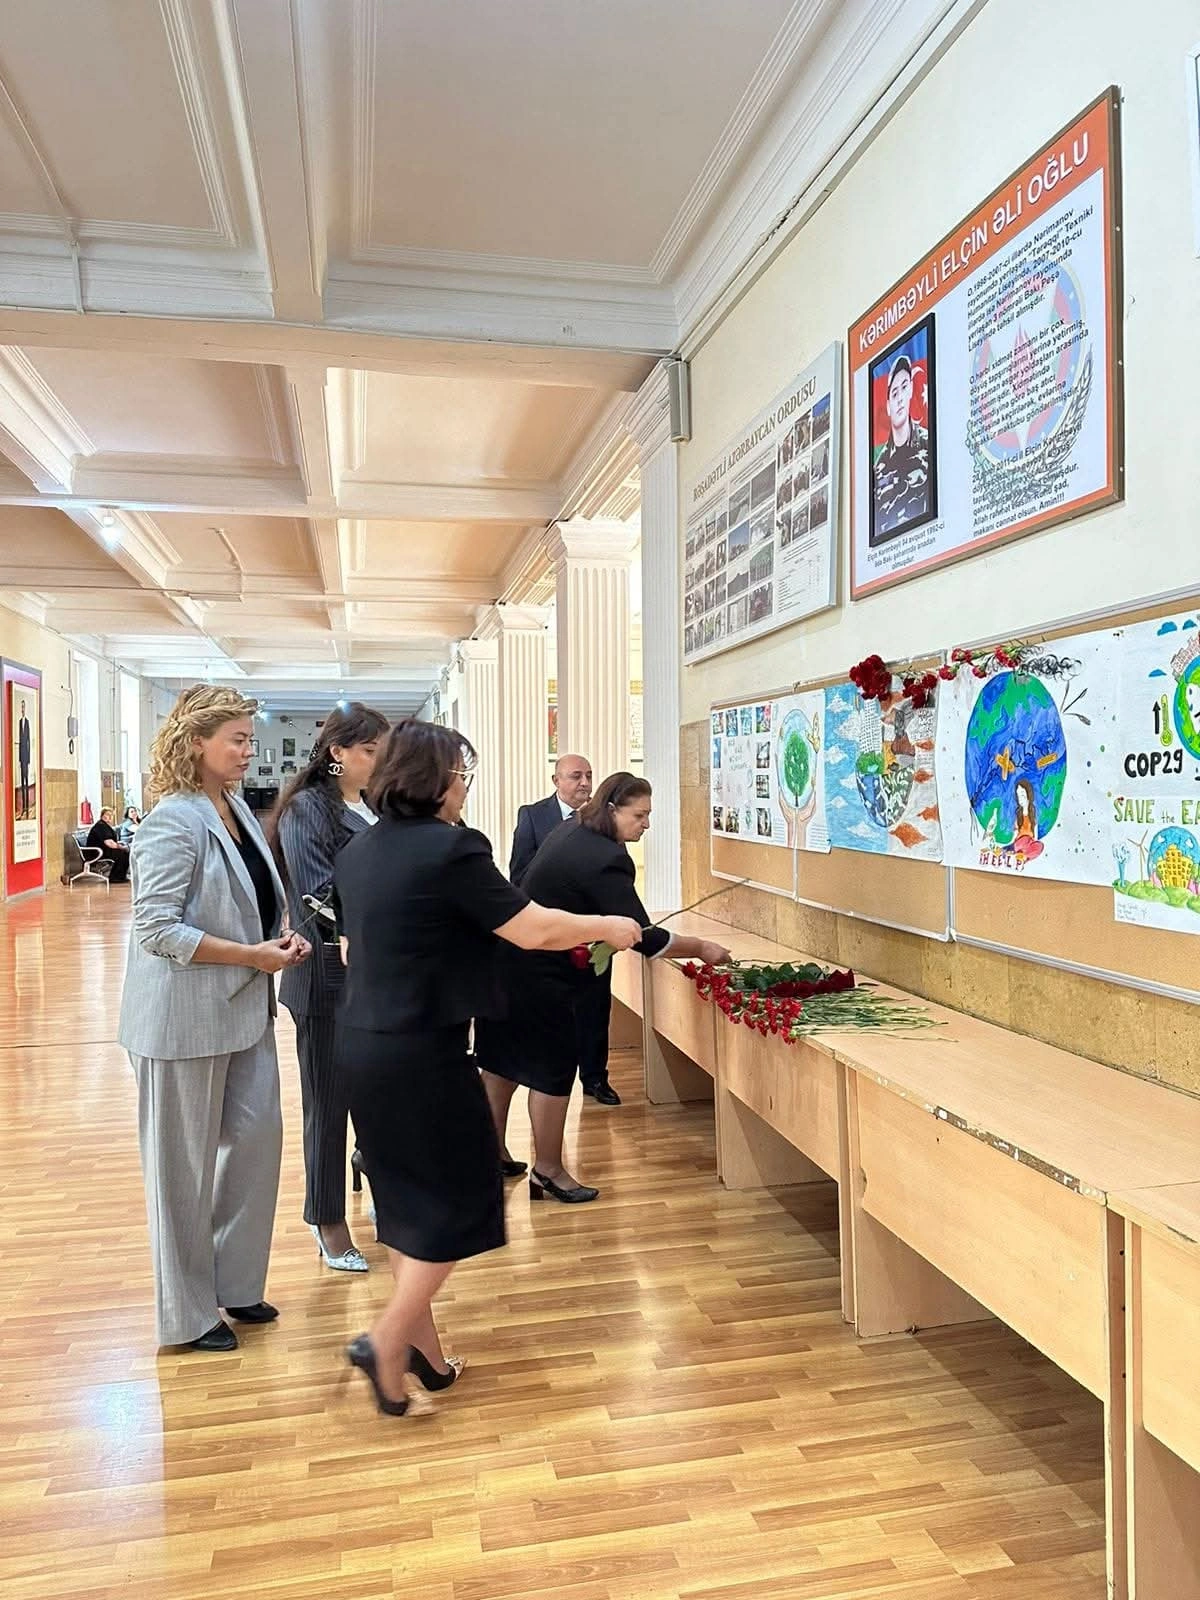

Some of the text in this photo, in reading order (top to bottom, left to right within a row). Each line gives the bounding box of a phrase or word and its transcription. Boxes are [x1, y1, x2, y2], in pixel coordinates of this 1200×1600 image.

[1034, 208, 1073, 245] Nərimanov
[1065, 204, 1092, 233] Texniki
[859, 132, 1089, 352] KƏRİMBƏYLİ ELÇİN ƏLİ OĞLU
[996, 278, 1030, 309] Nərimanov
[1032, 248, 1072, 282] rayonunda
[993, 312, 997, 322] 3
[1039, 327, 1049, 339] bir
[1050, 317, 1064, 334] çox
[777, 376, 817, 425] ORDUSU
[1025, 443, 1040, 457] Elçin
[1124, 749, 1183, 778] COP29
[1114, 799, 1155, 824] SAVE
[1161, 808, 1175, 824] the
